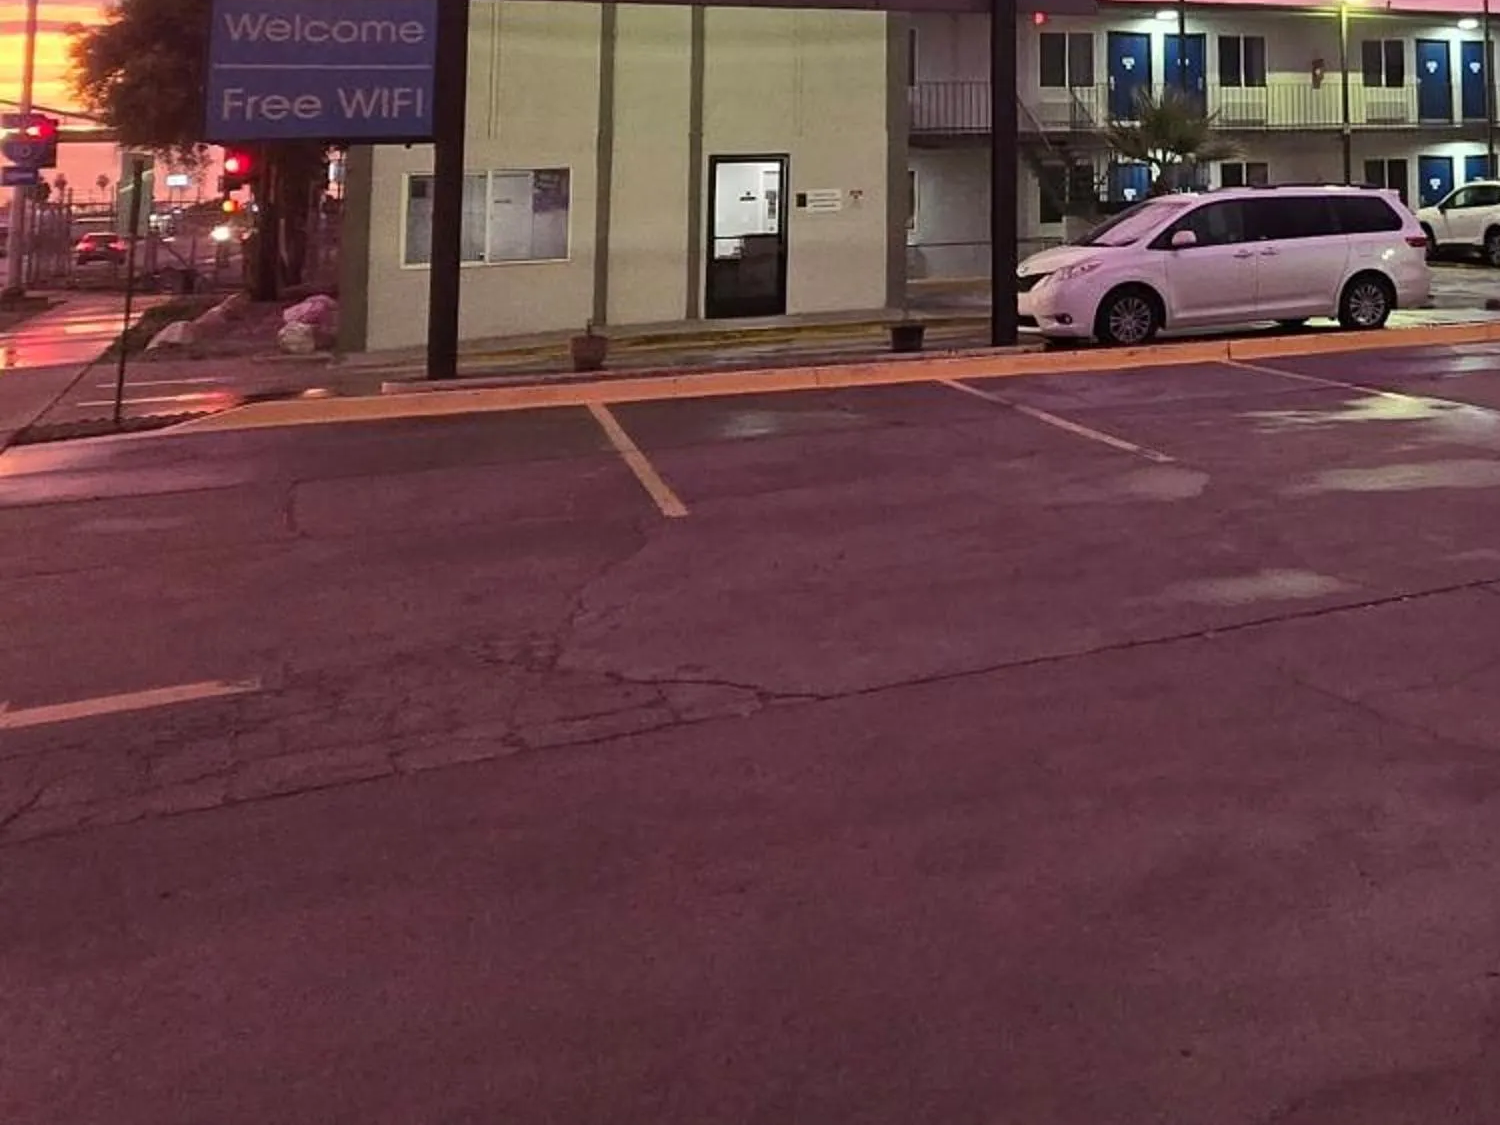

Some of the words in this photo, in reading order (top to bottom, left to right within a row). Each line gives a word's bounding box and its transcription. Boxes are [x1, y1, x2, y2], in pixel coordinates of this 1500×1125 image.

[224, 13, 425, 43] Welcome
[222, 87, 322, 120] Free
[338, 87, 424, 118] WIFI
